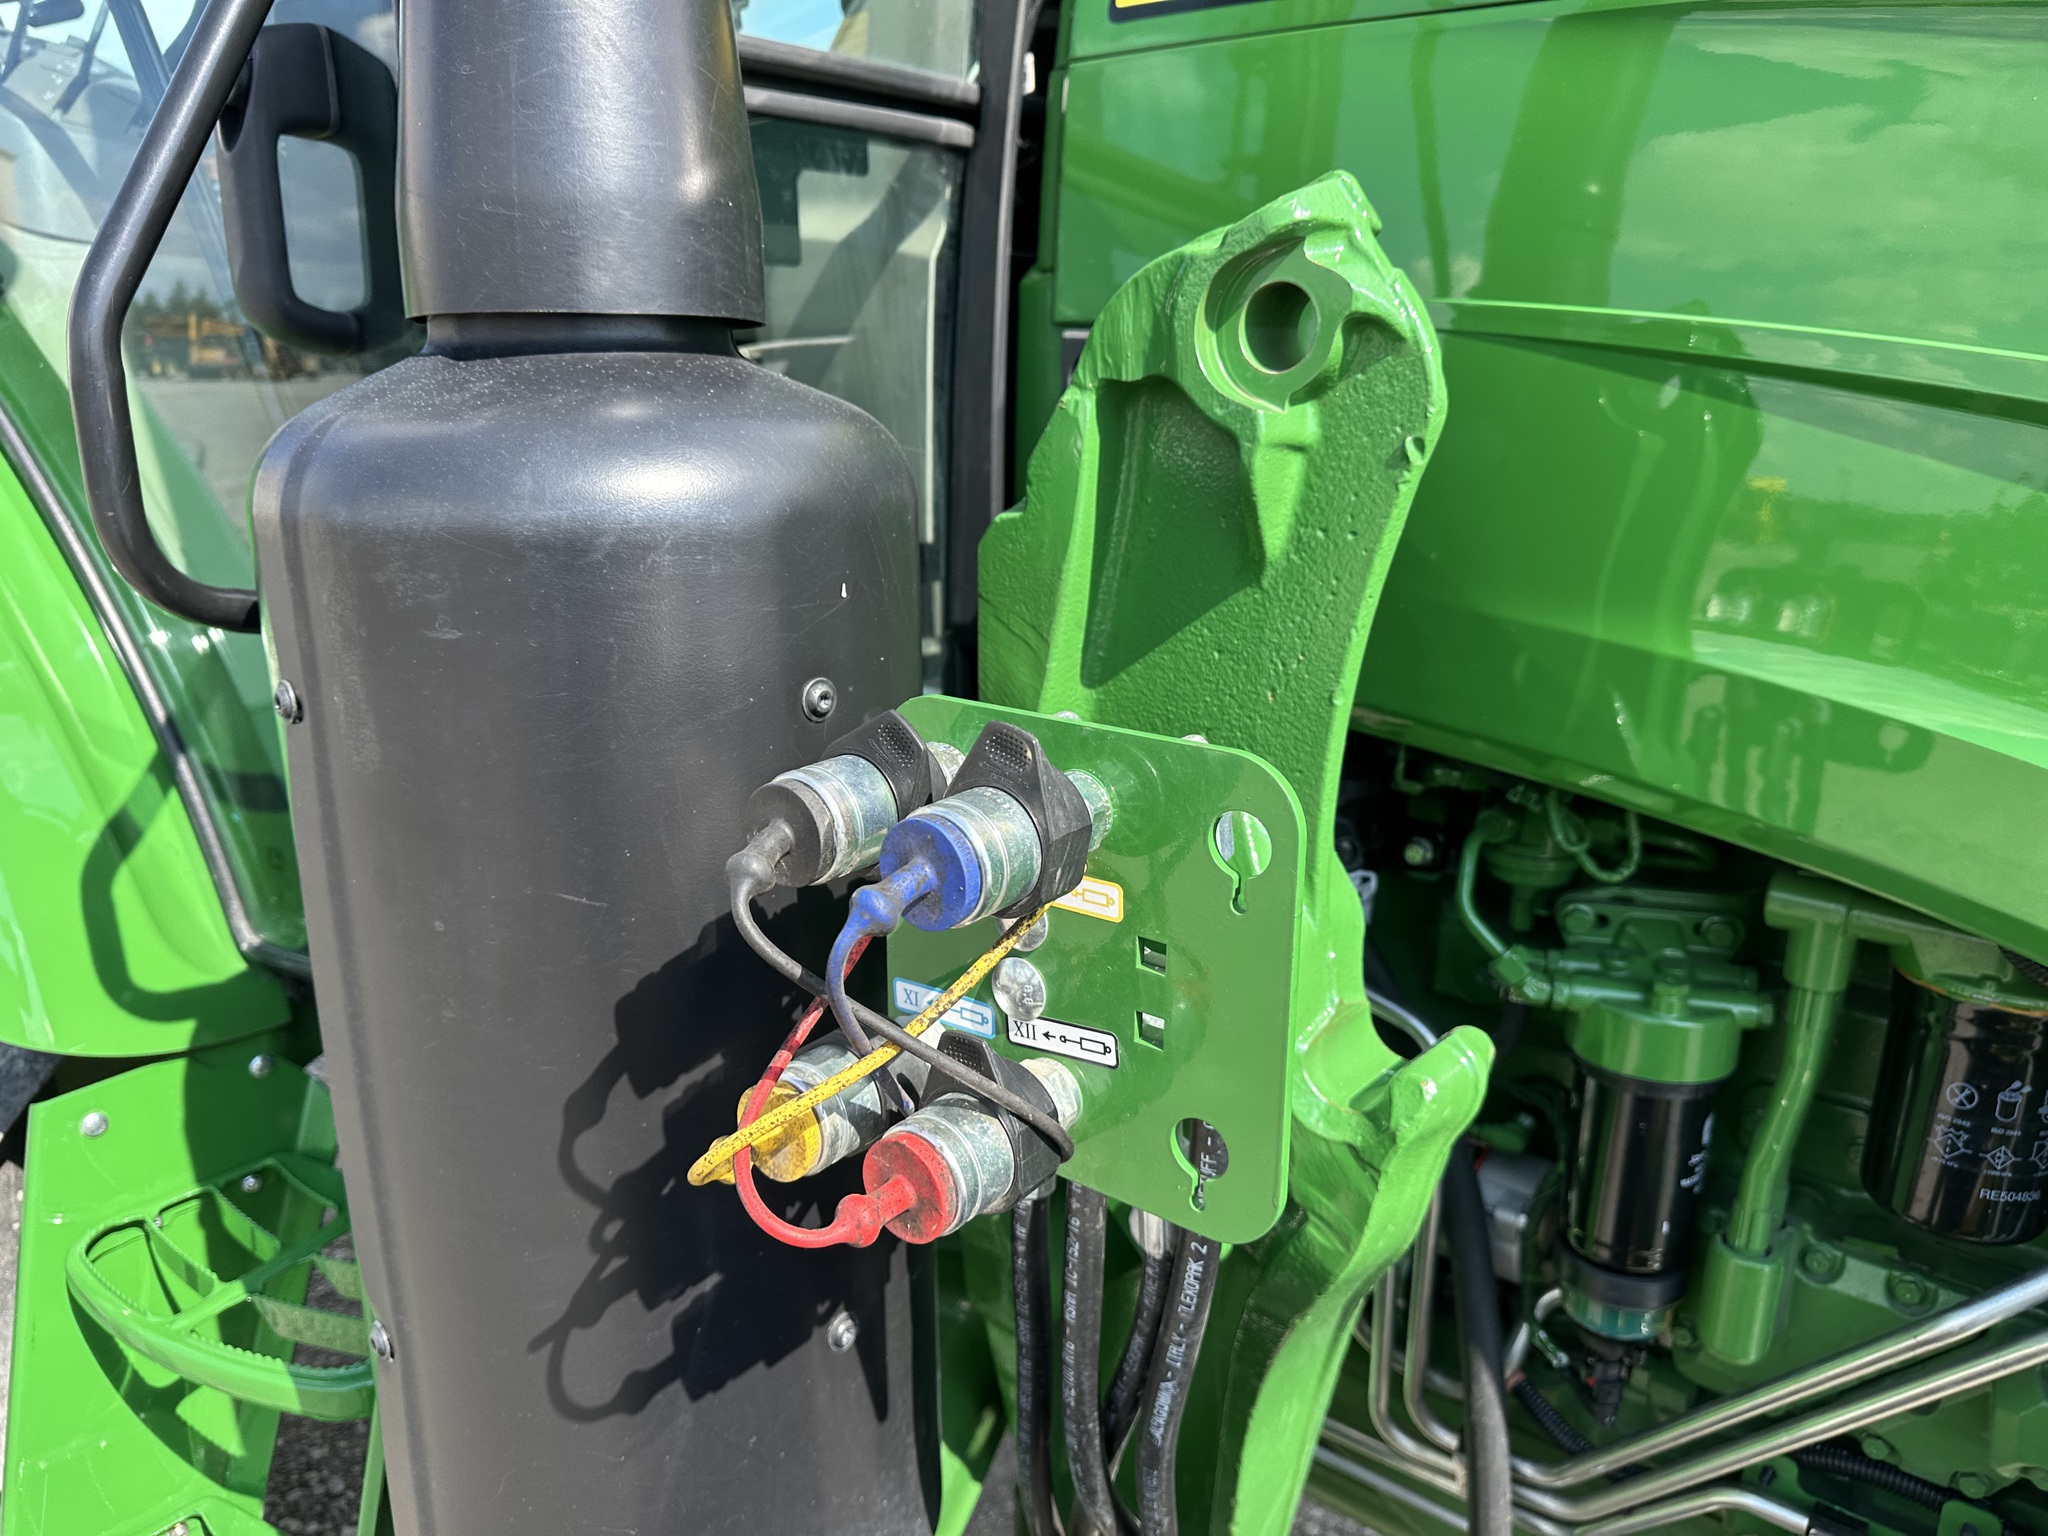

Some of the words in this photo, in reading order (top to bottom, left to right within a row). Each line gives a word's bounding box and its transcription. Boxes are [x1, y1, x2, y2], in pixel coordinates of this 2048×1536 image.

[902, 988, 920, 1007] XI
[1013, 1020, 1038, 1041] XII
[1165, 1331, 1187, 1369] ITALY
[1190, 1241, 1208, 1256] 2
